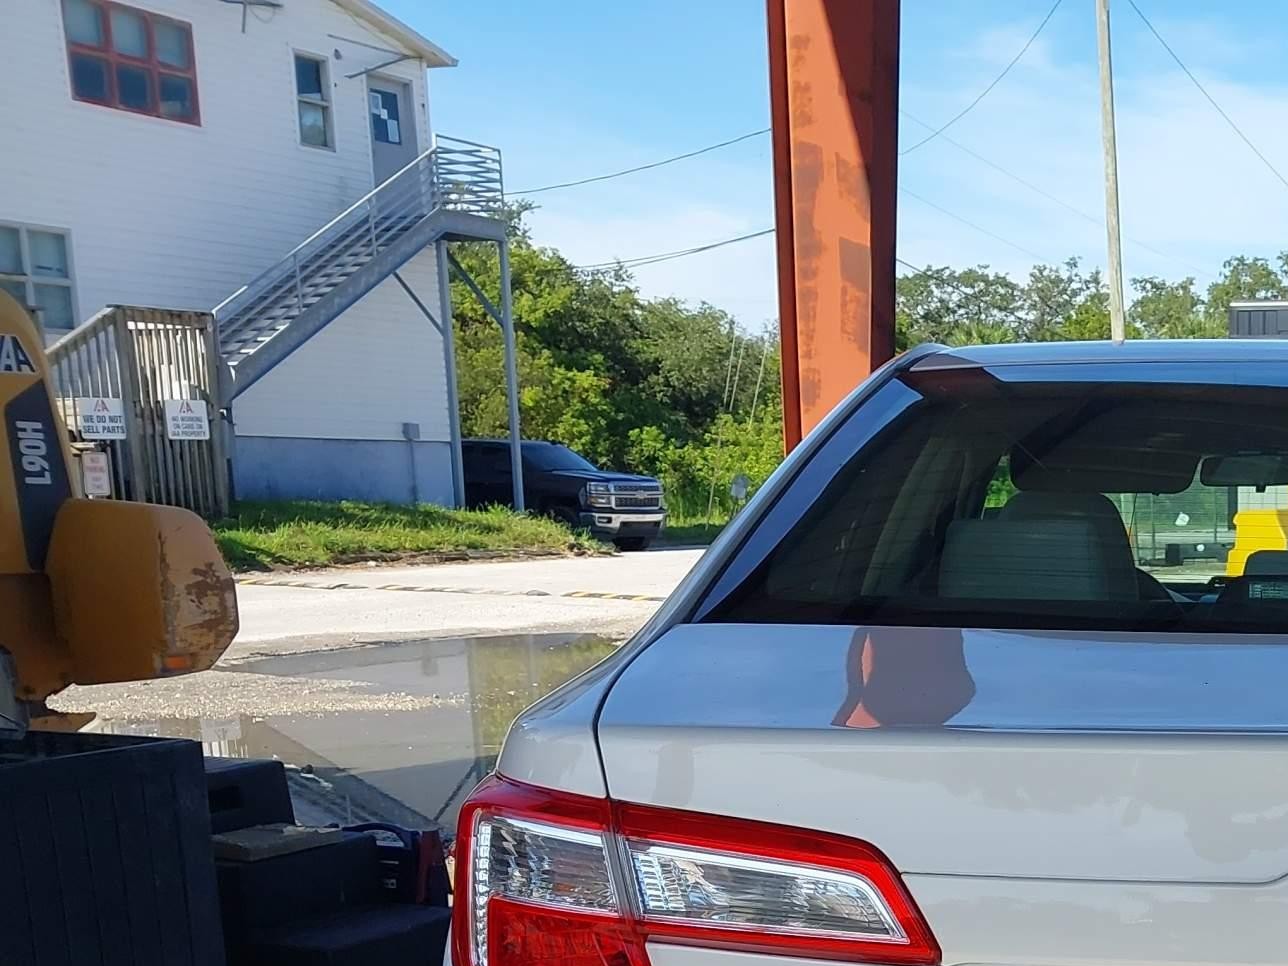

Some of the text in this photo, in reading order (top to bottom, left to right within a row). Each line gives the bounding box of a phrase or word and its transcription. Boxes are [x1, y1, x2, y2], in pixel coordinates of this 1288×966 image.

[82, 415, 122, 424] WE DO NOT
[82, 425, 125, 434] SELL PARTS
[15, 420, 52, 485] L90H
